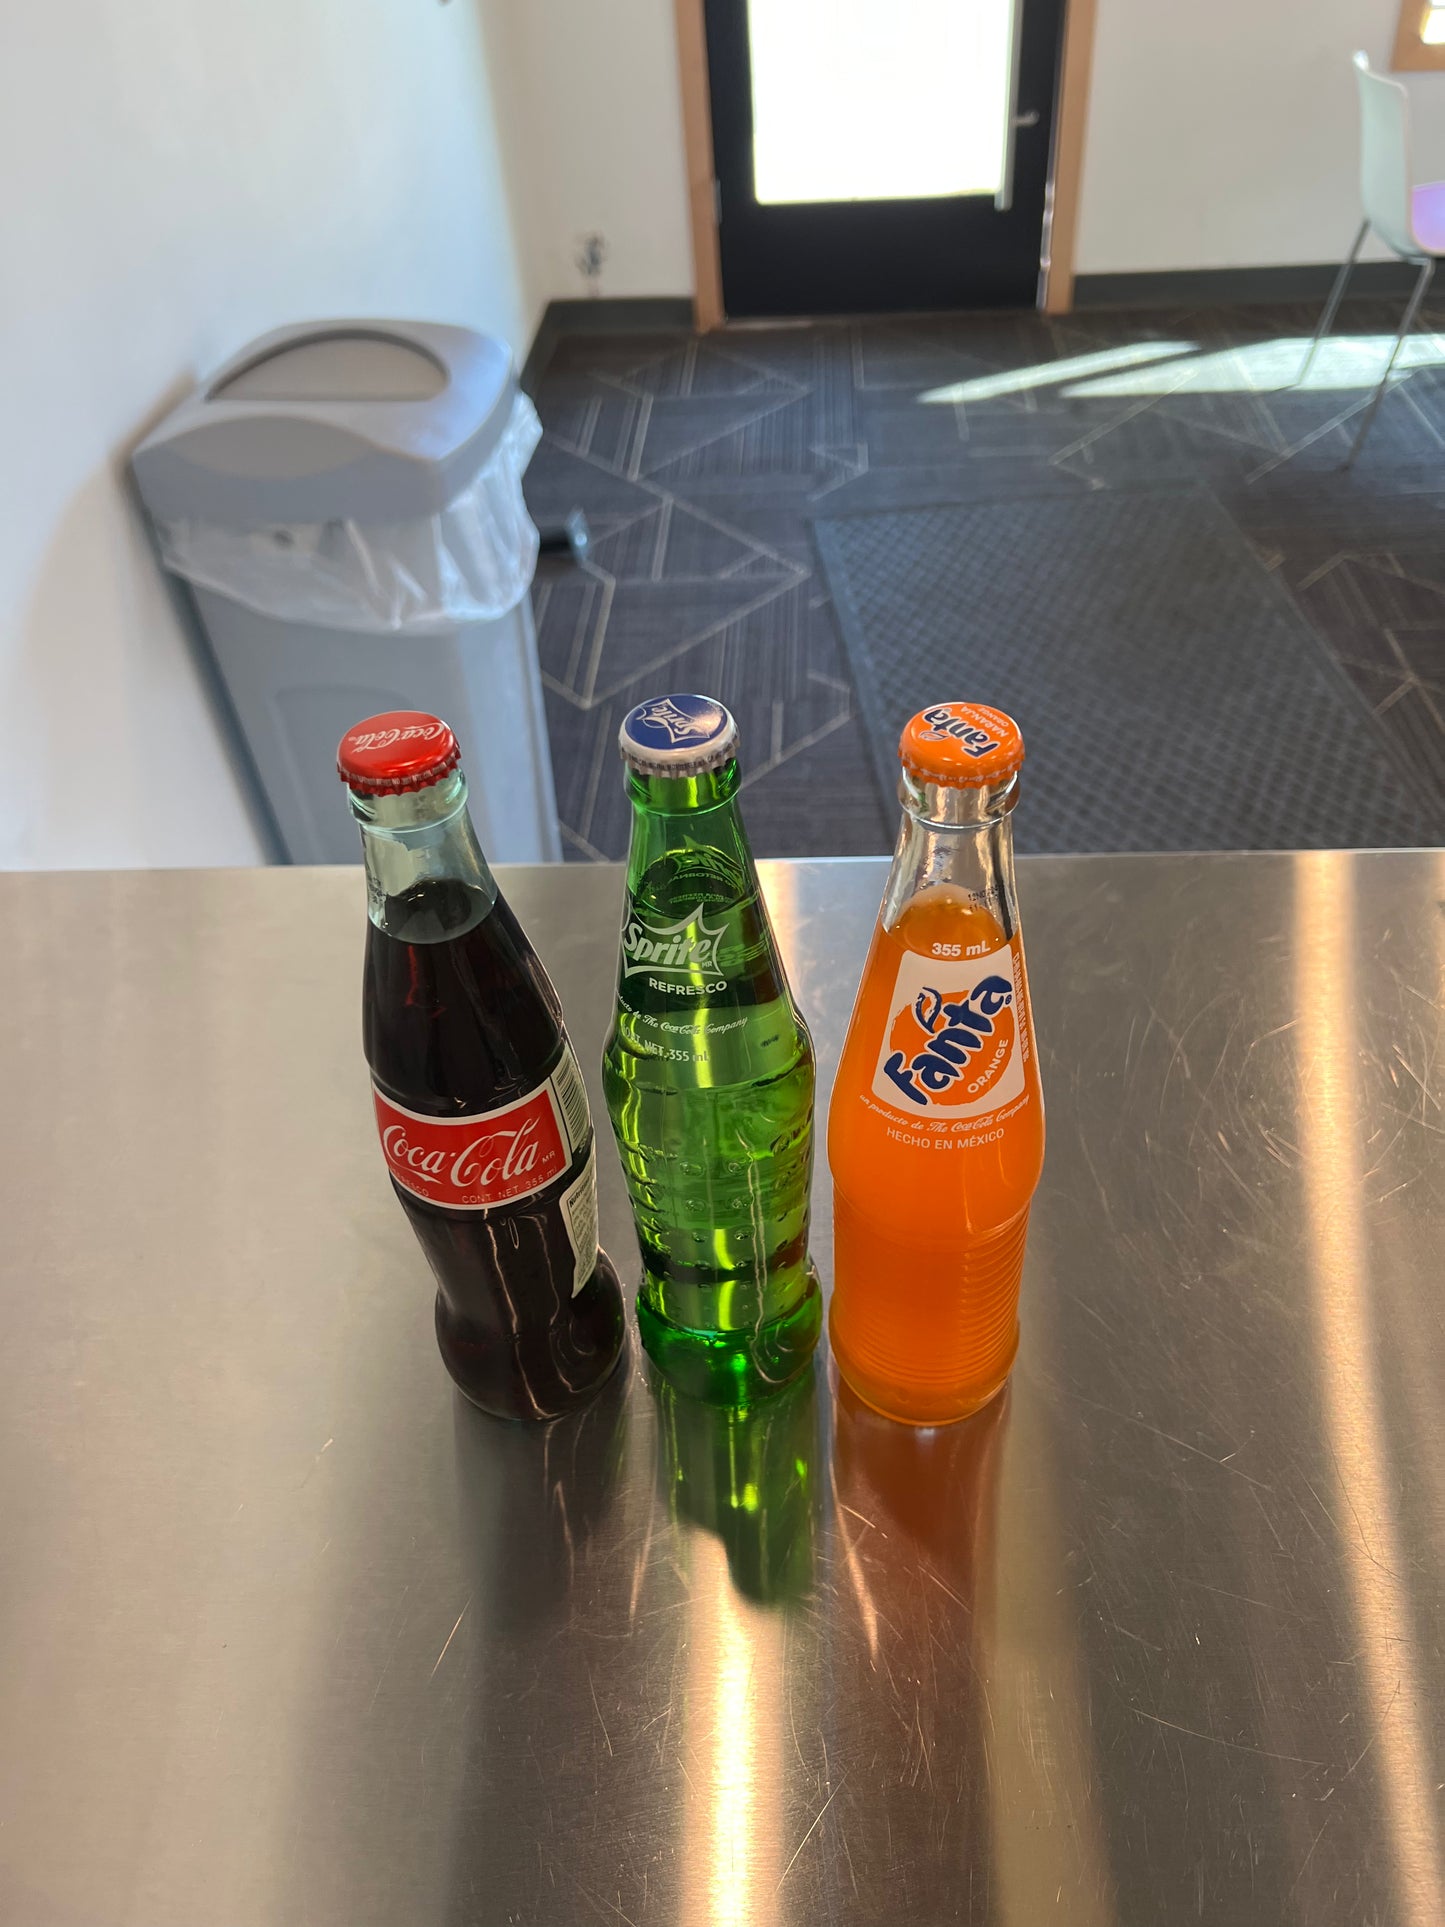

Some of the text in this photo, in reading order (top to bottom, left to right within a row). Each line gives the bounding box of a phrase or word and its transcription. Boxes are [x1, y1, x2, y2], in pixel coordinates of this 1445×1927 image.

[961, 706, 1009, 738] NARANJA
[979, 707, 1010, 727] ORANGE
[351, 722, 445, 753] Coca-Cola
[923, 709, 1000, 758] Fanta
[623, 922, 712, 966] Sprite
[931, 940, 992, 957] 355 mL
[701, 960, 713, 969] MR
[649, 977, 728, 996] REFRESCO
[642, 1014, 659, 1028] The
[703, 1017, 749, 1035] Company
[883, 975, 1013, 1106] Fanta
[668, 1048, 690, 1062] 355
[967, 1038, 1009, 1094] ORANGE
[859, 1094, 871, 1105] un
[867, 1099, 908, 1127] producto
[910, 1120, 925, 1131] de
[926, 1121, 948, 1134] The
[995, 1094, 1030, 1123] Company
[886, 1126, 1005, 1150] HECHO EN MÉXICO
[382, 1114, 542, 1188] Coca-Cola
[542, 1150, 556, 1165] MR
[525, 1174, 545, 1191] 355
